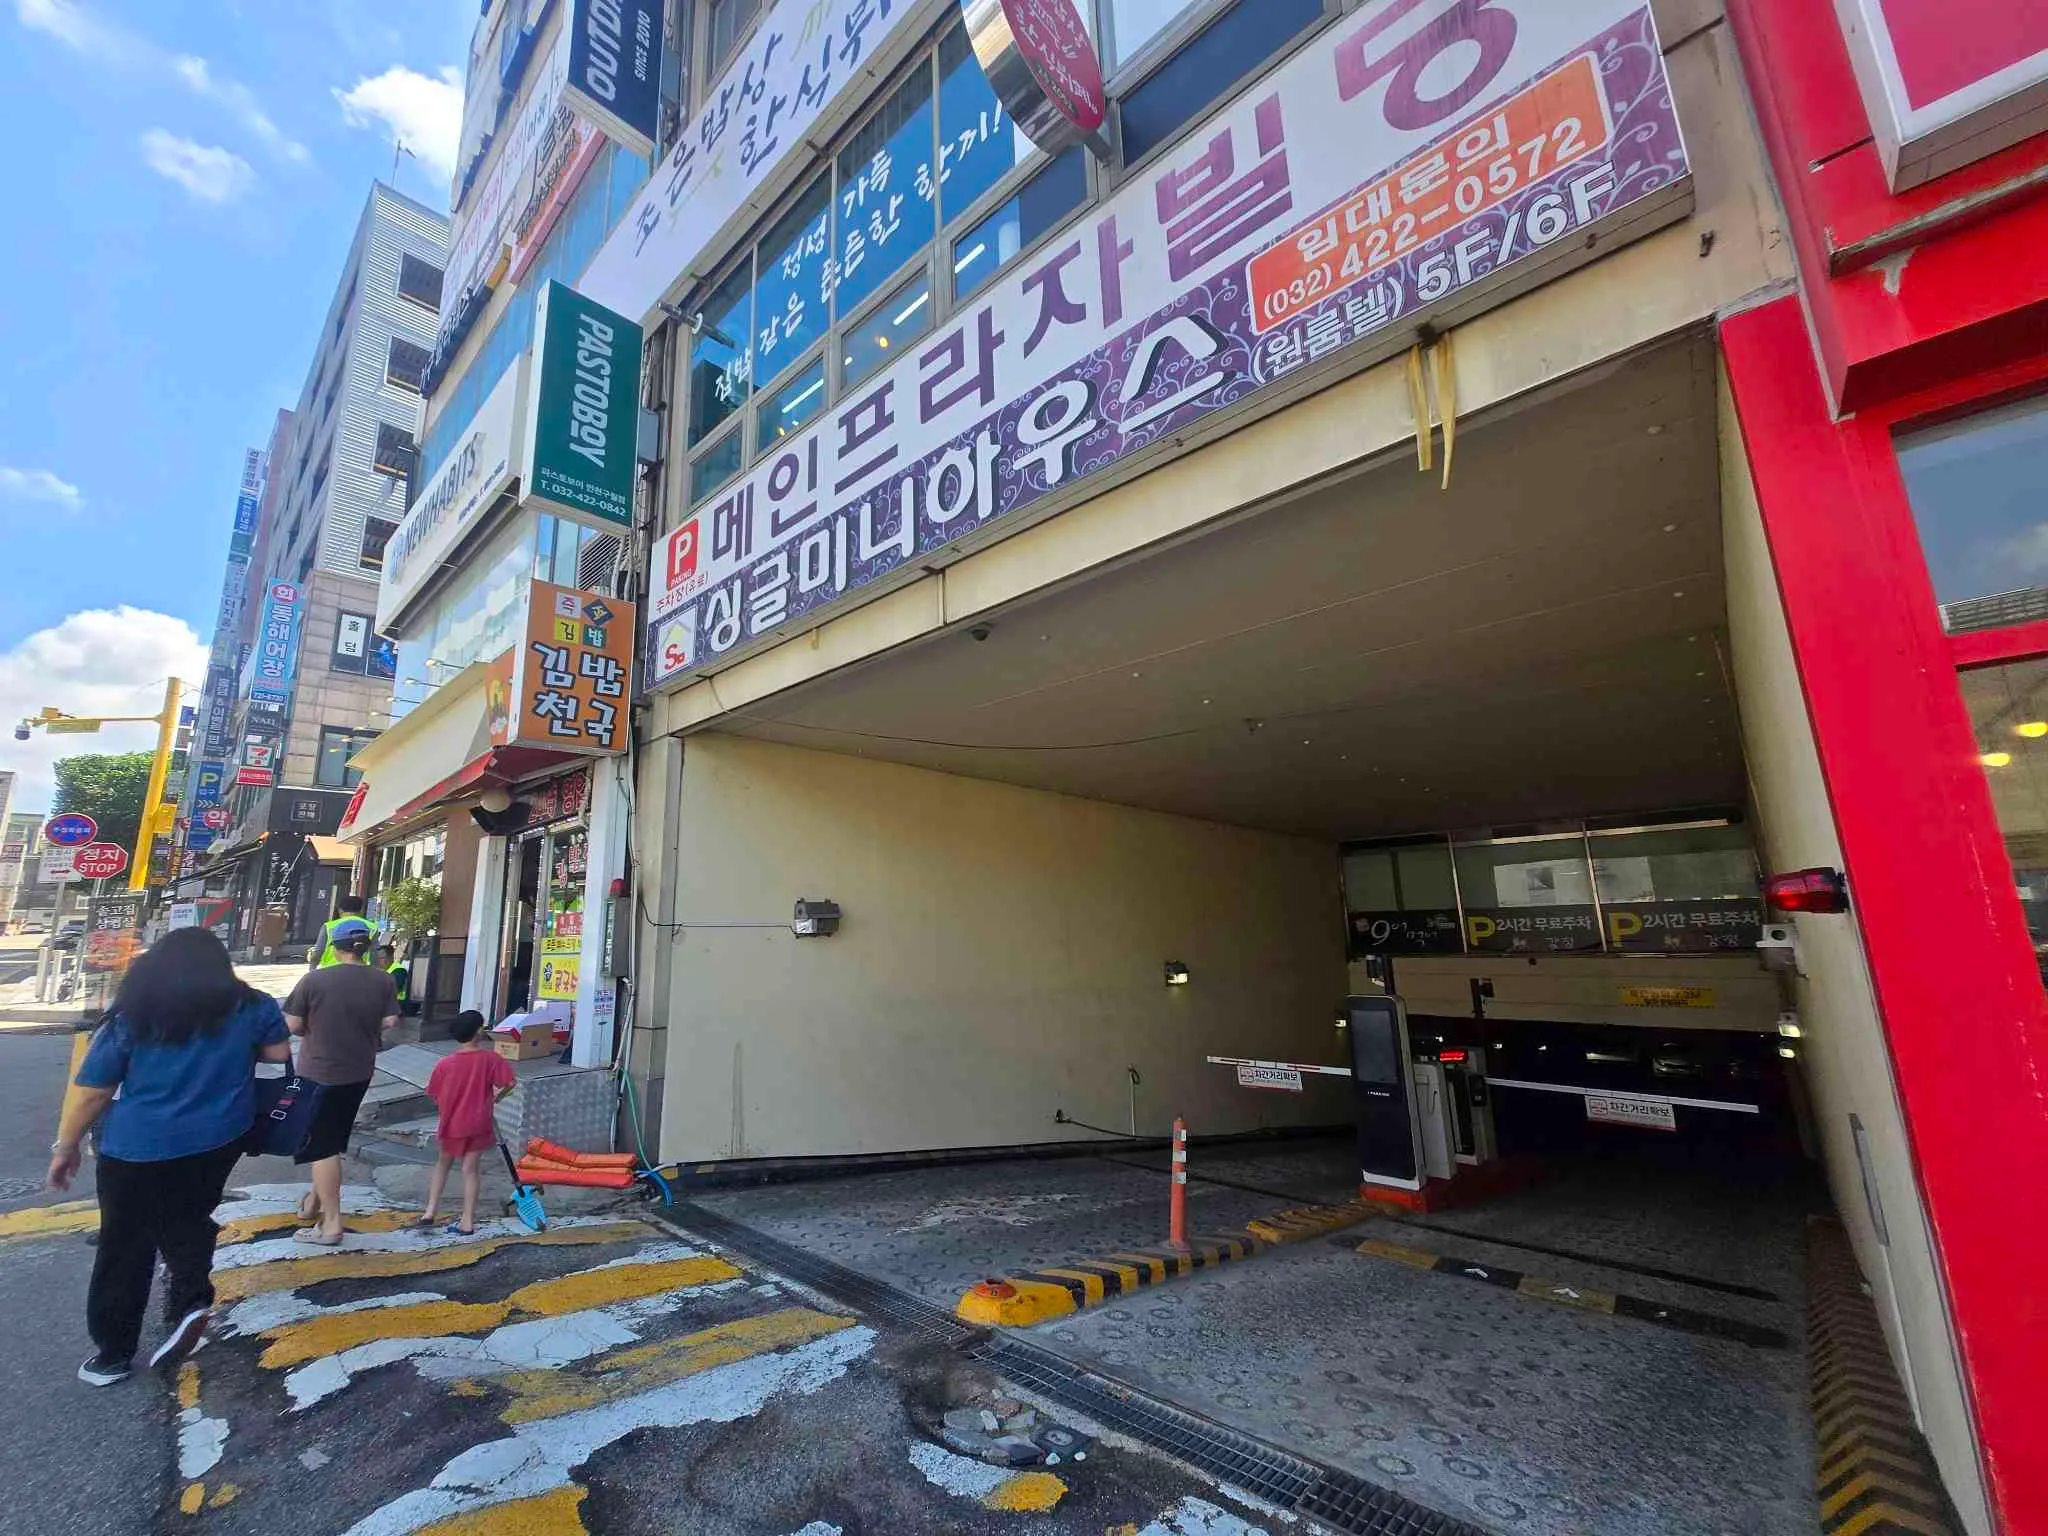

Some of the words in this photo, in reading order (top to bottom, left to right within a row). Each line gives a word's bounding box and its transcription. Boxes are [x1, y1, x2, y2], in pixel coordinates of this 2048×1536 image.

[636, 9, 651, 48] 2010
[634, 45, 648, 81] SINCE
[1296, 112, 1510, 264] 임대문의
[782, 214, 827, 280] 정성
[844, 150, 893, 218] 가득
[1416, 161, 1617, 303] 5F/6F
[569, 312, 614, 468] PASTOBOY
[541, 466, 584, 490] 파스토보이
[551, 483, 627, 517] 032-422-0842
[674, 530, 692, 575] P
[263, 604, 294, 678] 동해어장
[532, 641, 626, 698] 김밥
[533, 690, 618, 748] 천국
[208, 809, 229, 827] 약
[78, 862, 118, 874] STOP
[83, 848, 121, 862] 정지
[1468, 916, 1496, 946] P
[1496, 917, 1533, 932] 2시간
[1535, 915, 1593, 931] 무료주차
[1608, 912, 1643, 948] P
[1643, 912, 1686, 929] 2시간
[1690, 911, 1760, 927] 무료주차
